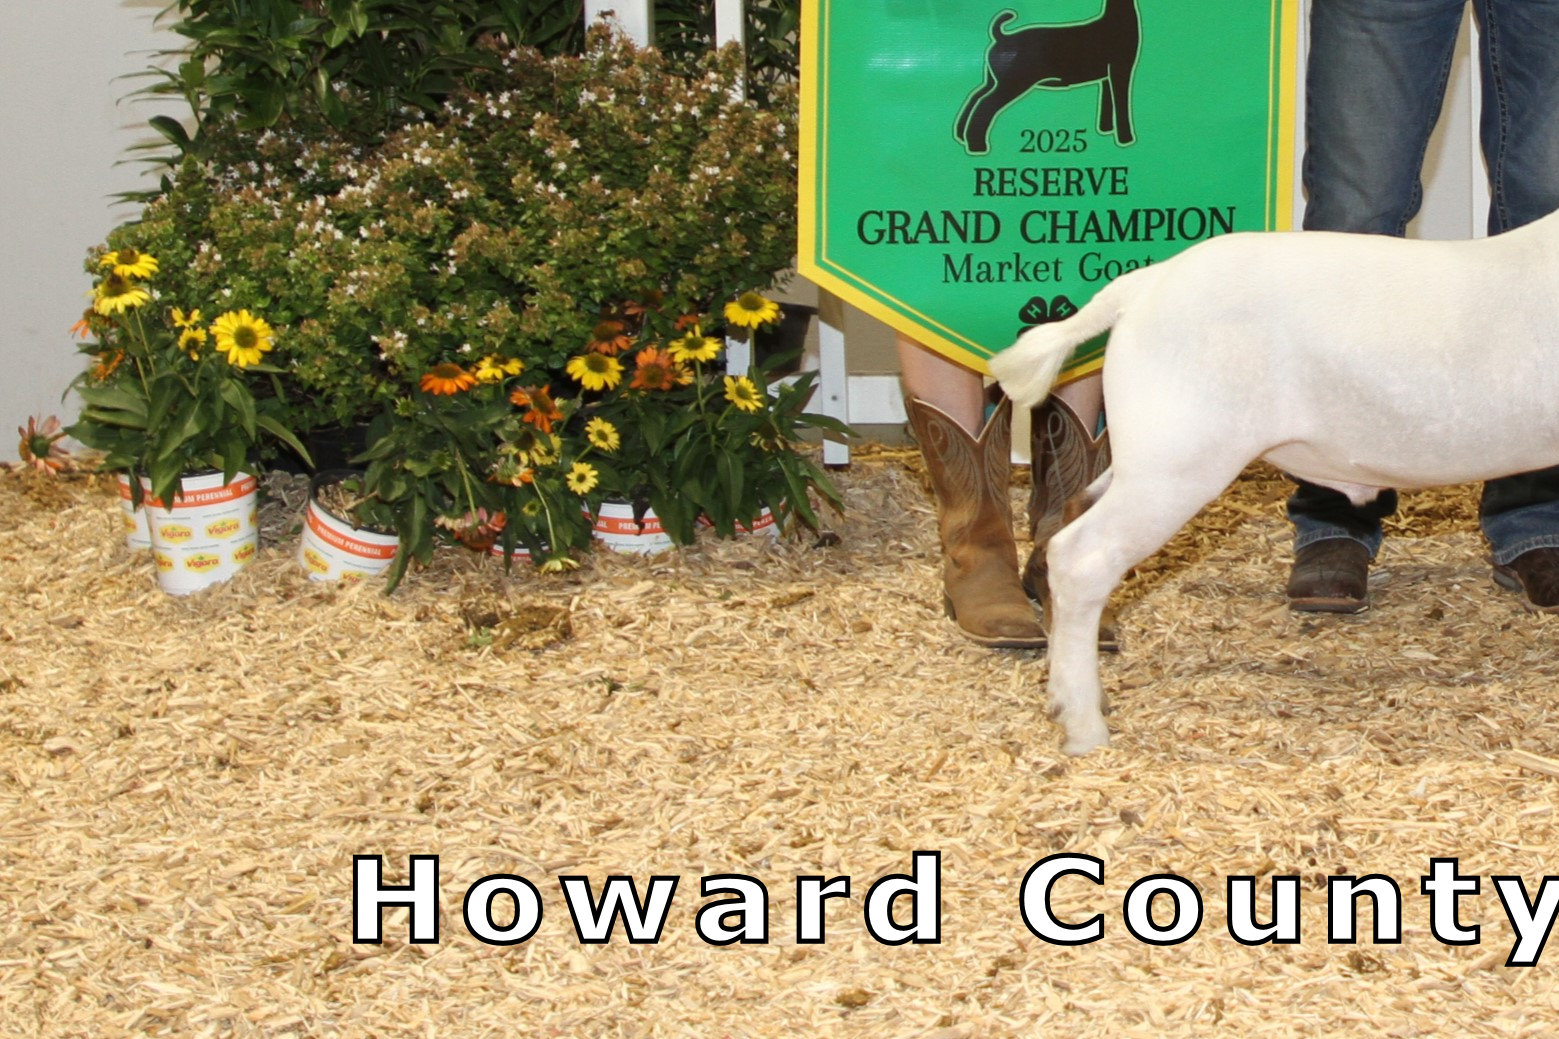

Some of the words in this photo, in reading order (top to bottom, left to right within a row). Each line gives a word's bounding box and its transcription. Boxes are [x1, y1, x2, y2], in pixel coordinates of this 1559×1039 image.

[1019, 129, 1088, 153] 2025
[973, 166, 1129, 197] RESERVE
[857, 210, 1000, 245] GRAND
[1019, 207, 1236, 244] CHAMPION
[942, 252, 1063, 283] Market
